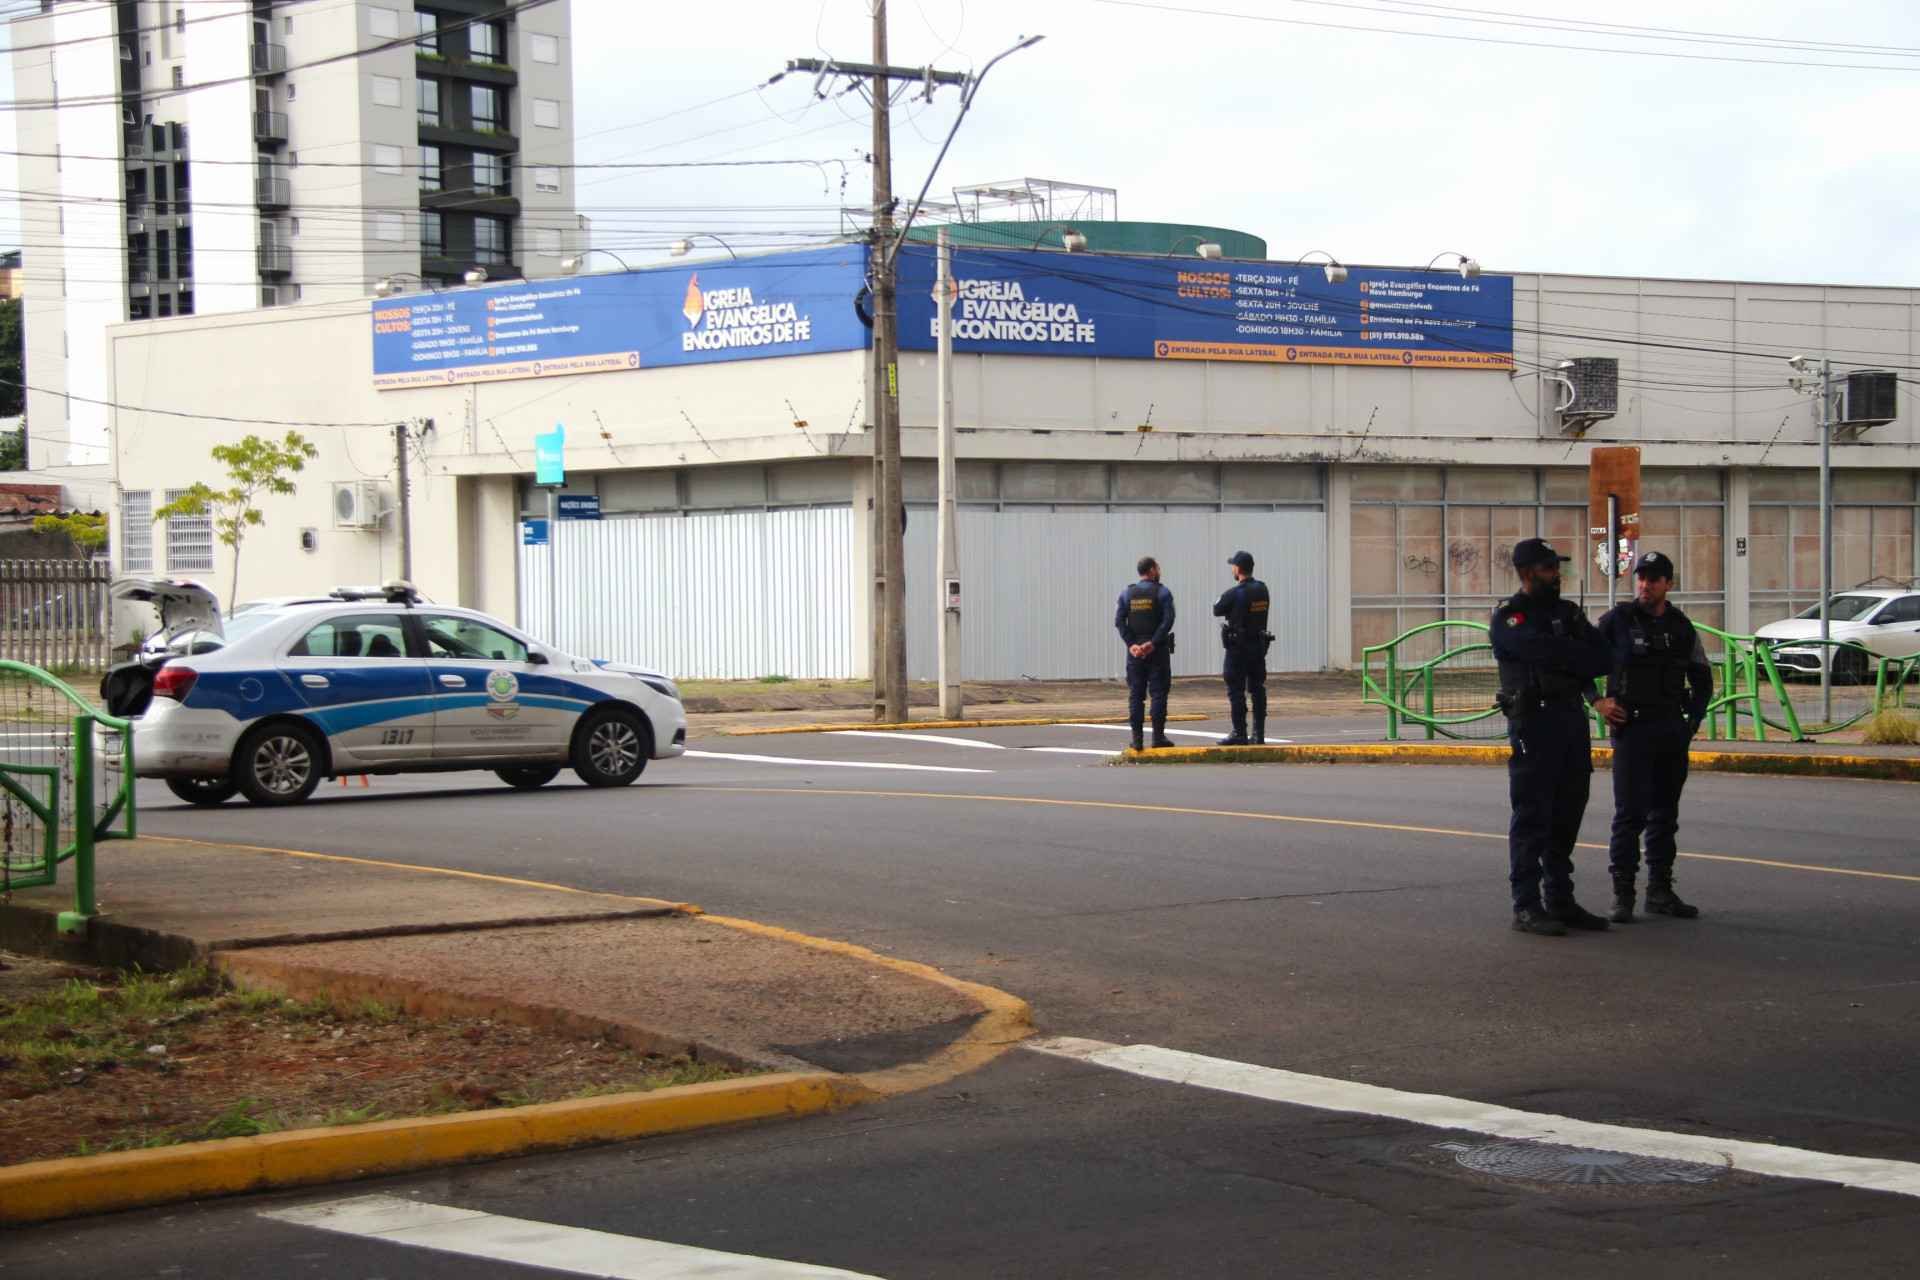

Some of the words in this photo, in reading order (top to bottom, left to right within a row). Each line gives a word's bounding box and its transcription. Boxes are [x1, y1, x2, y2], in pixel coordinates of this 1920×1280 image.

[958, 279, 1024, 301] IGREJA
[1177, 272, 1230, 285] NOSSOS
[703, 287, 753, 310] IGREJA
[1238, 287, 1264, 296] SEXTA
[707, 299, 797, 329] EVANGÉLICA
[963, 297, 1079, 323] EVANGÉLICA
[682, 325, 772, 351] ENCONTROS
[774, 323, 793, 343] DE
[794, 314, 811, 340] FÉ
[1051, 323, 1074, 342] DE
[1076, 318, 1096, 343] FÉ
[381, 729, 415, 745] 1317
